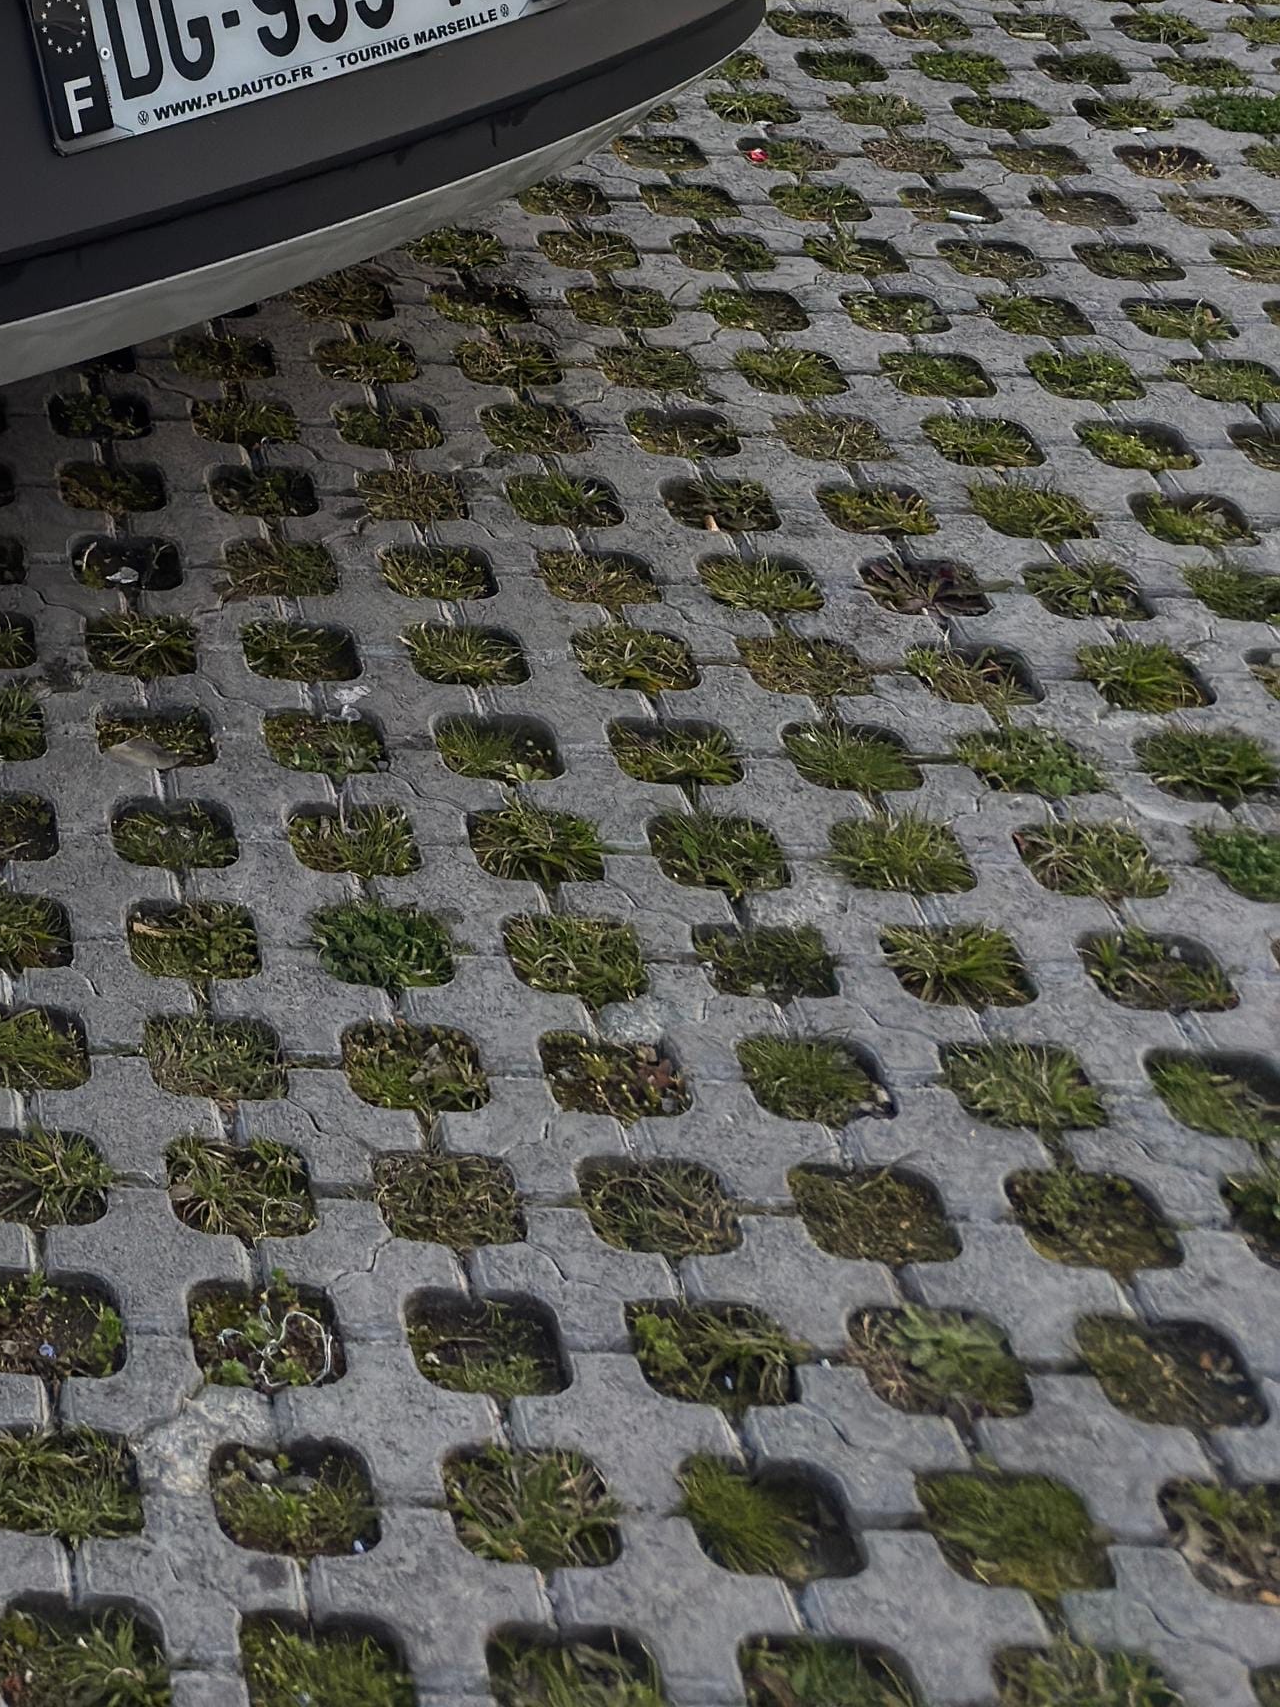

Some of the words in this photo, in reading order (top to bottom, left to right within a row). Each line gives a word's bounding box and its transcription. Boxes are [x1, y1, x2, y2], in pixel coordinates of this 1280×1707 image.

[63, 75, 94, 134] F
[154, 65, 313, 122] WWW.PLDAUTO.FR
[336, 36, 410, 67] TOURING
[413, 7, 498, 50] MARSEILLE
